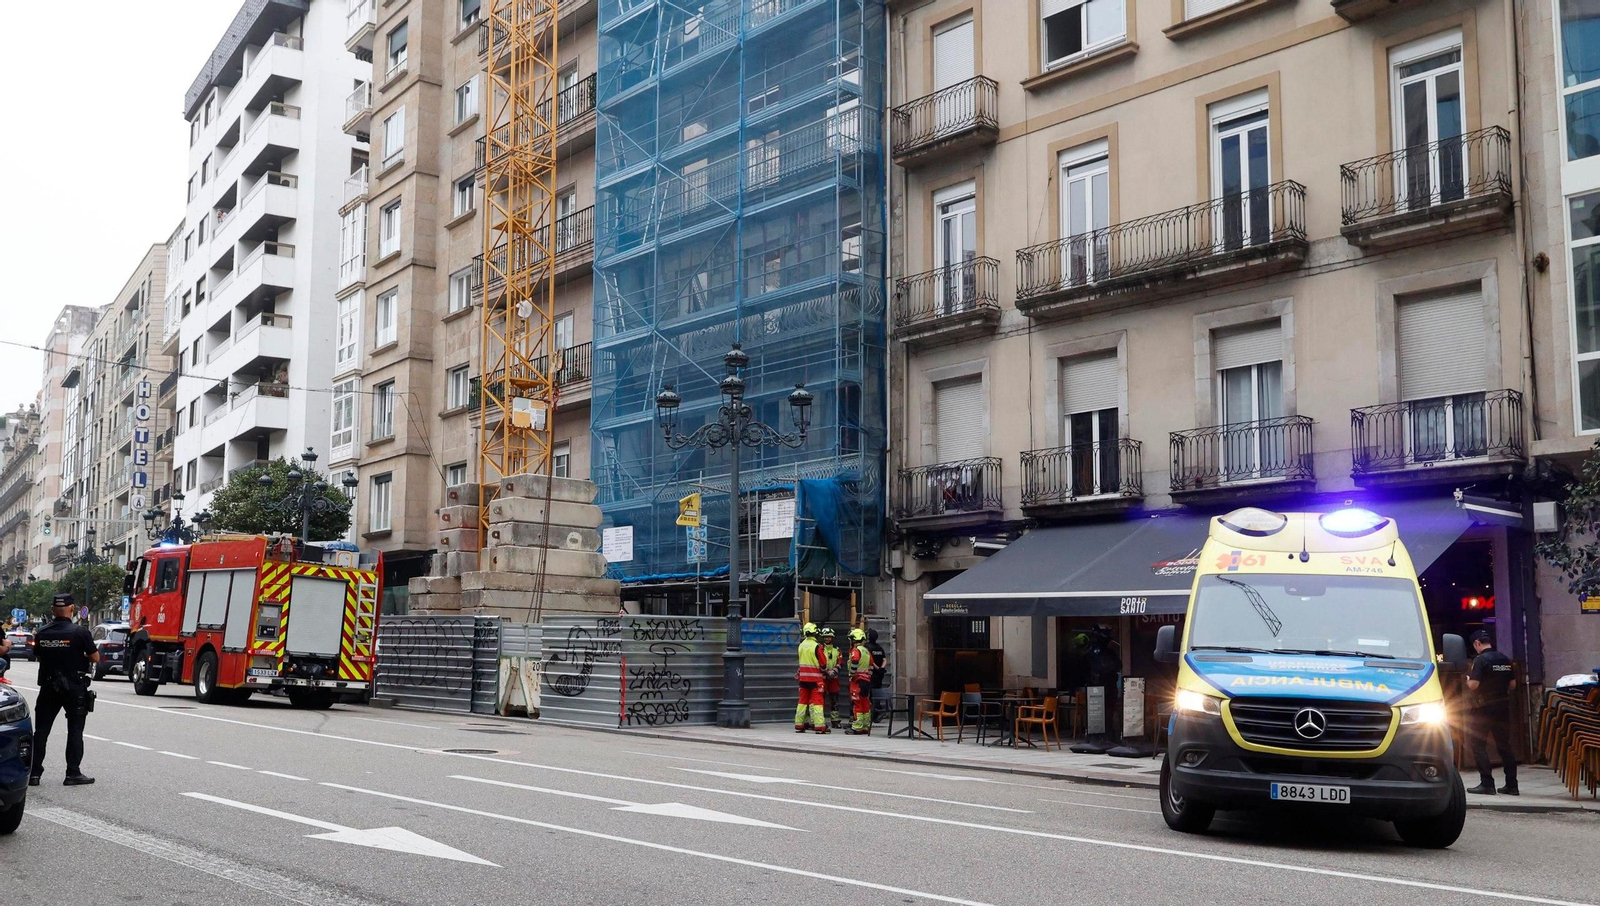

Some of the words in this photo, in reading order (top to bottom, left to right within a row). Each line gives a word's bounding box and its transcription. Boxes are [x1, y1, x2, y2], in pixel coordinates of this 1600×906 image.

[135, 382, 151, 488] HOTEL
[1340, 555, 1383, 566] SVA
[1345, 566, 1384, 574] AM-746
[1461, 596, 1495, 610] 106
[1142, 614, 1180, 623] SANTO
[1280, 785, 1315, 799] 8843
[1320, 787, 1347, 801] LDD
